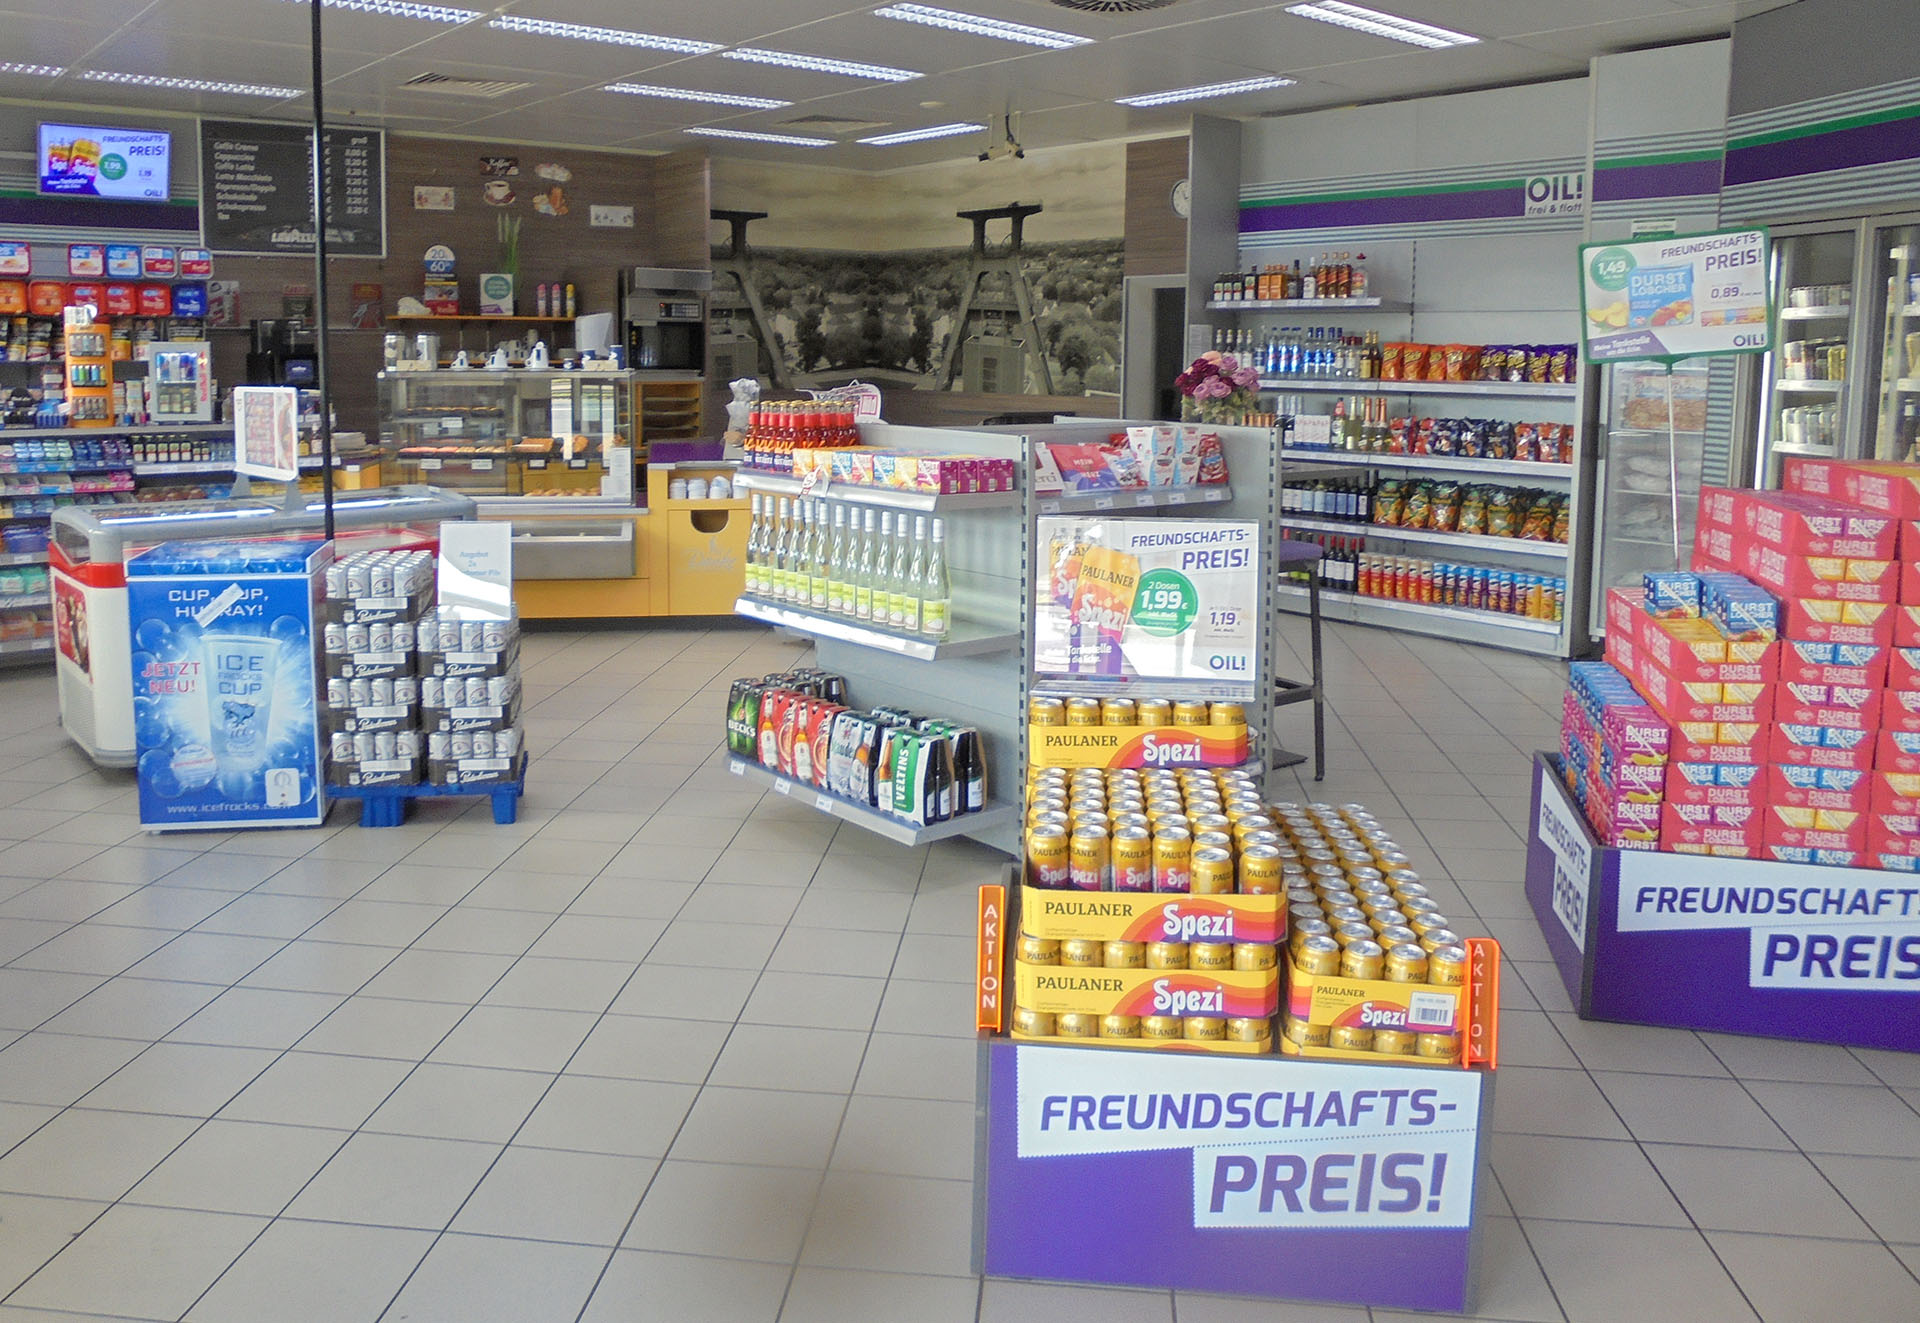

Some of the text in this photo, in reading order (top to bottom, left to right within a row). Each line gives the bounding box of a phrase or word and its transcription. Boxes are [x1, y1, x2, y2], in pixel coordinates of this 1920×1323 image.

[129, 145, 165, 156] PREIS!
[1528, 175, 1582, 202] OIL!
[1528, 203, 1582, 214] frei & flott
[1661, 233, 1761, 258] FREUNDSCHAFTS-
[1705, 248, 1762, 271] PREIS!
[1632, 272, 1686, 288] DURST
[1711, 287, 1739, 299] 0,89
[1733, 334, 1764, 347] OIL!
[1035, 472, 1057, 482] erci
[1131, 529, 1250, 547] FREUNDSCHAFTS-
[1833, 539, 1876, 551] DURST
[1182, 548, 1249, 570] PREIS!
[1081, 565, 1135, 588] PAULANER
[1837, 582, 1880, 593] DURST
[1141, 590, 1183, 610] 1,99
[1209, 612, 1236, 626] 1,19
[1831, 625, 1874, 637] DURST
[141, 661, 200, 677] JETZT
[217, 655, 264, 671] ICE
[1209, 655, 1246, 671] OIL!
[1719, 664, 1762, 674] DURST
[1824, 667, 1867, 678] DURST
[149, 679, 196, 695] NEU!
[218, 681, 262, 695] CUP
[1713, 705, 1755, 715] DURST
[1818, 709, 1861, 720] DURST
[1046, 734, 1201, 766] PAULANER Spezi
[1710, 745, 1752, 756] DURST
[1812, 749, 1855, 760] DURST
[895, 748, 910, 801] VELTINS
[1708, 788, 1750, 798] DURST
[1809, 791, 1852, 801] DURST
[1704, 828, 1745, 838] DURST
[1805, 831, 1848, 842] DURST
[1616, 839, 1656, 850] DURST
[1045, 902, 1234, 940] PAULANER Spezi
[981, 904, 998, 1009] AKTION
[1036, 976, 1223, 1016] PAULANER Spezi
[1470, 943, 1485, 1057] AKTION
[1316, 985, 1366, 998] PAULANER
[1360, 1001, 1406, 1027] Spezi
[1040, 1089, 1457, 1132] FREUNDSCHAFTS-
[1209, 1153, 1448, 1214] PREIS!
